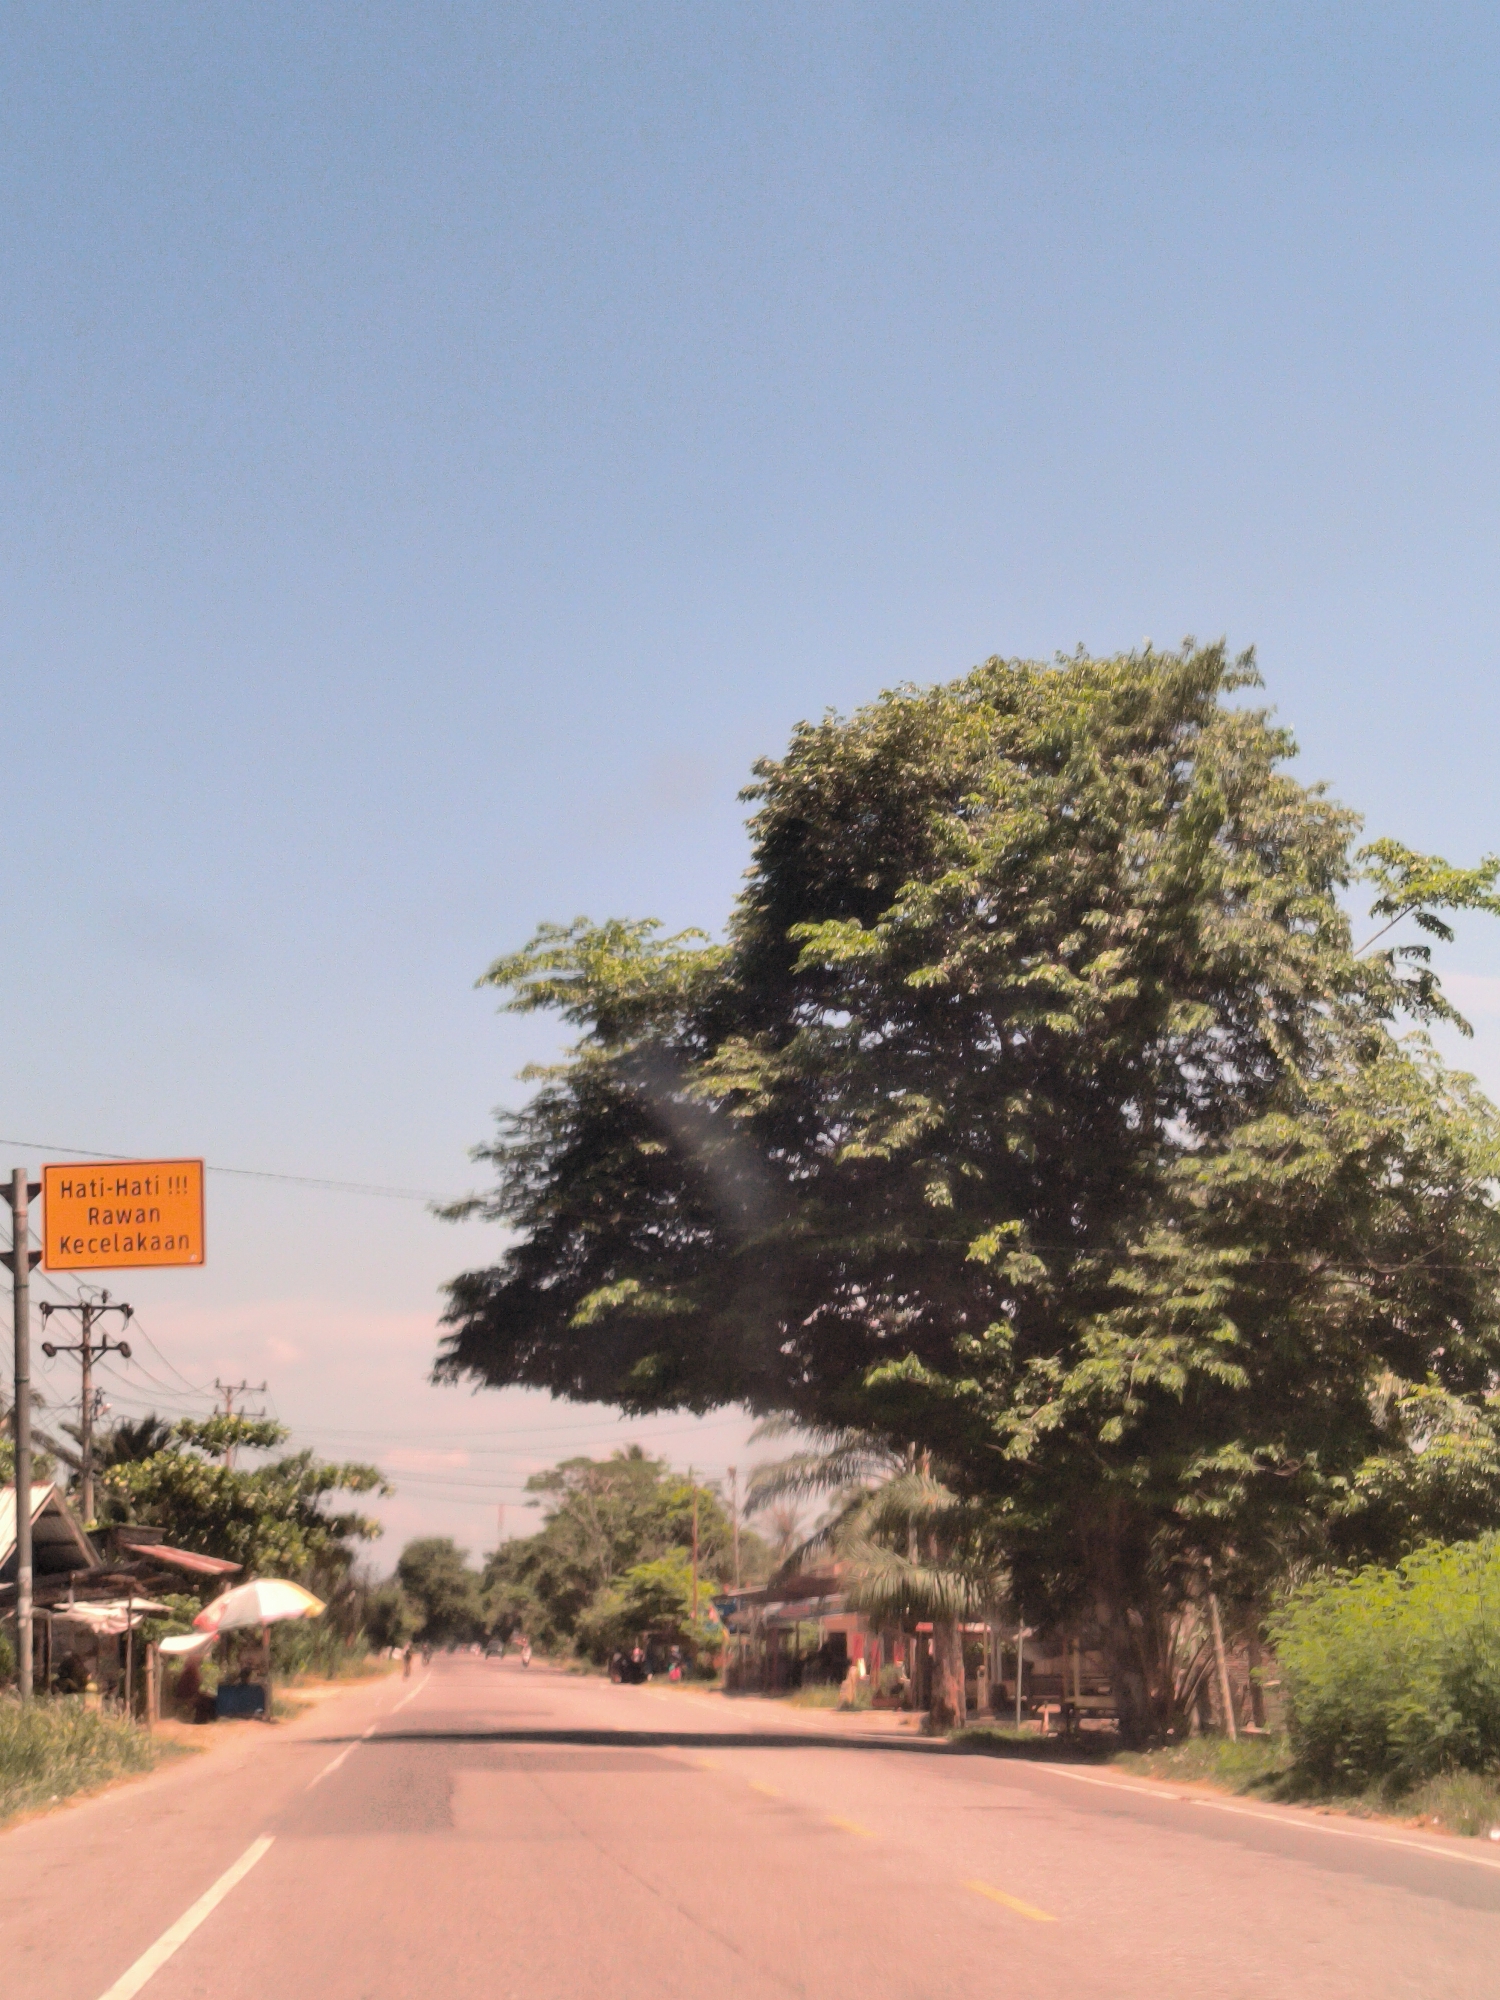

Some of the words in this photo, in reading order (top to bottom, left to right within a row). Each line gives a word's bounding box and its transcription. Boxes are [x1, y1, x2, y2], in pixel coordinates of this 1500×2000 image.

[60, 1175, 160, 1199] Hati-Hati
[88, 1207, 161, 1226] Rawan
[60, 1232, 190, 1255] Kecelakaan
